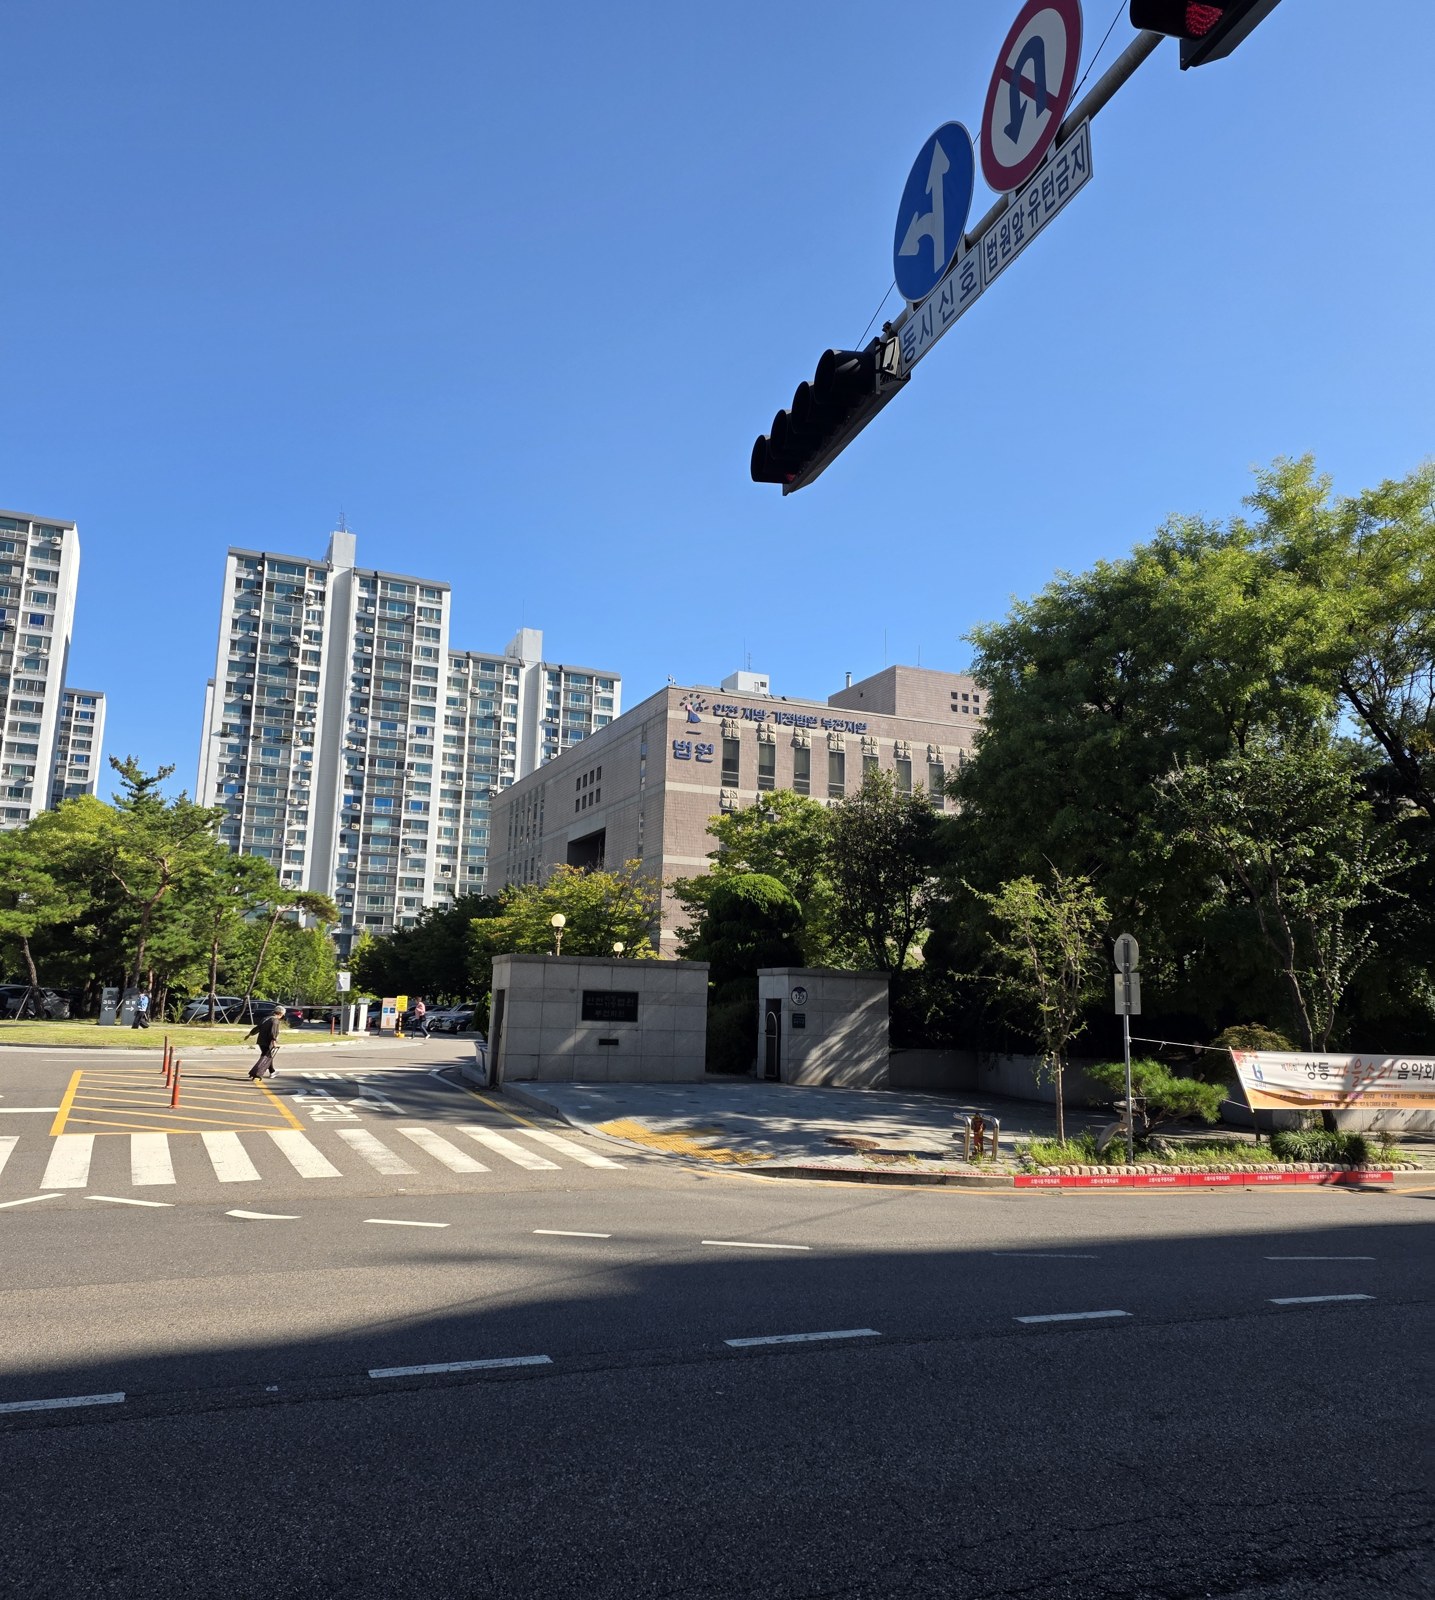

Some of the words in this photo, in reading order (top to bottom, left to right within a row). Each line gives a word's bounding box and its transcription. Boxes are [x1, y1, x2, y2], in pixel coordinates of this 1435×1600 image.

[986, 207, 1025, 273] 법원앞
[1027, 134, 1085, 228] 유턴금지
[672, 739, 715, 763] 법원
[1304, 1061, 1330, 1080] 상동
[1332, 1058, 1395, 1088] 가을소리
[1397, 1062, 1435, 1081] 음악회
